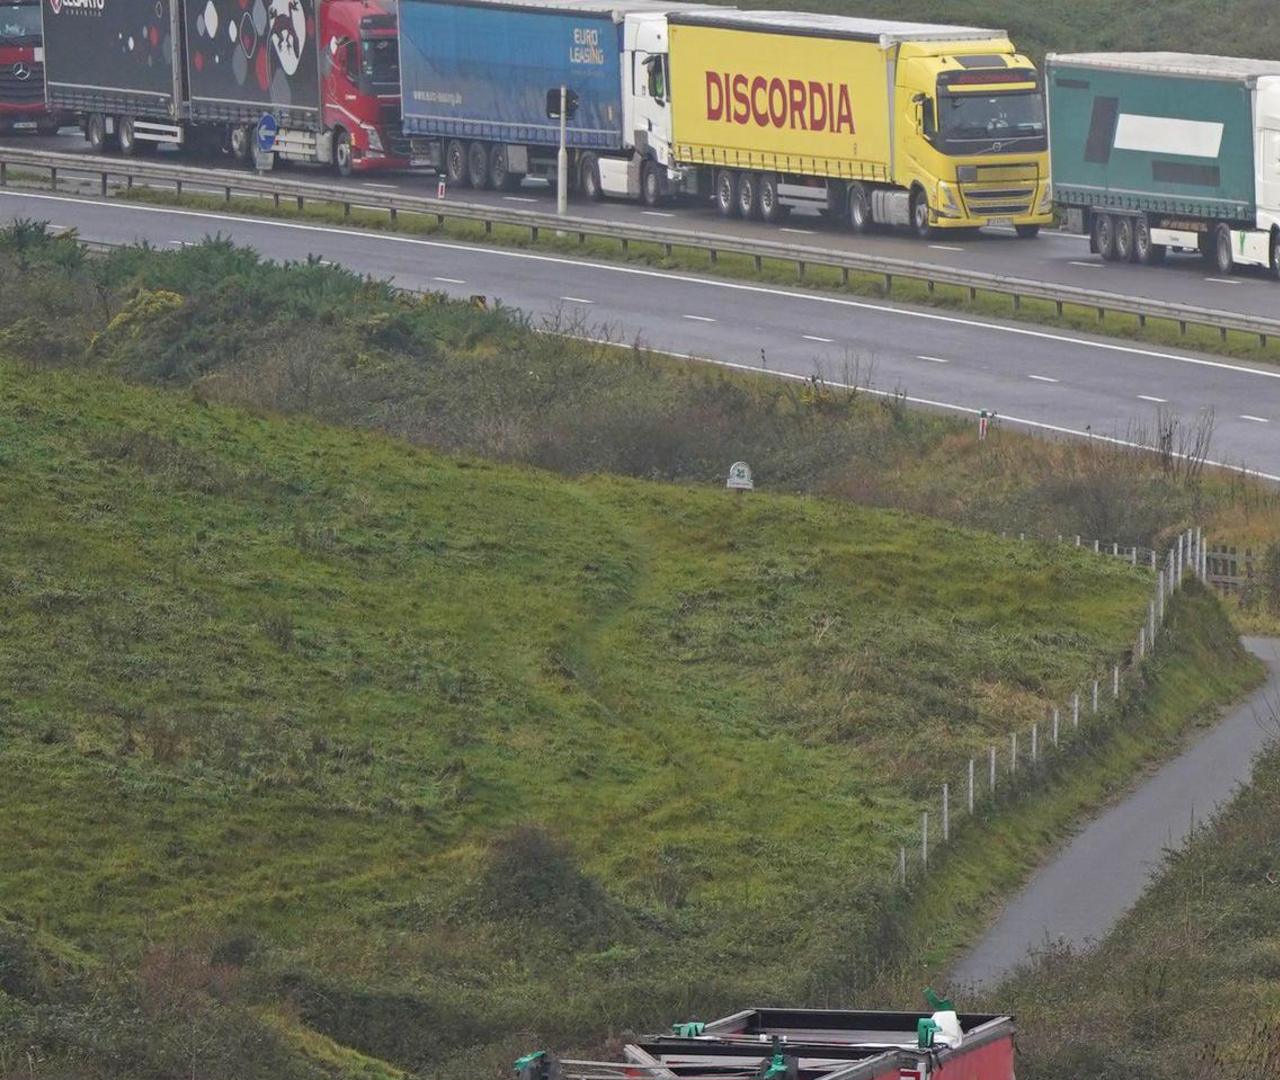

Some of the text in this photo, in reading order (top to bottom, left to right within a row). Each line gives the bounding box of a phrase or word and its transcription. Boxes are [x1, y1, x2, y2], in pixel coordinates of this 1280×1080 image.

[574, 28, 598, 45] EURO
[570, 47, 604, 64] LEASING
[705, 70, 856, 135] DISCORDIA
